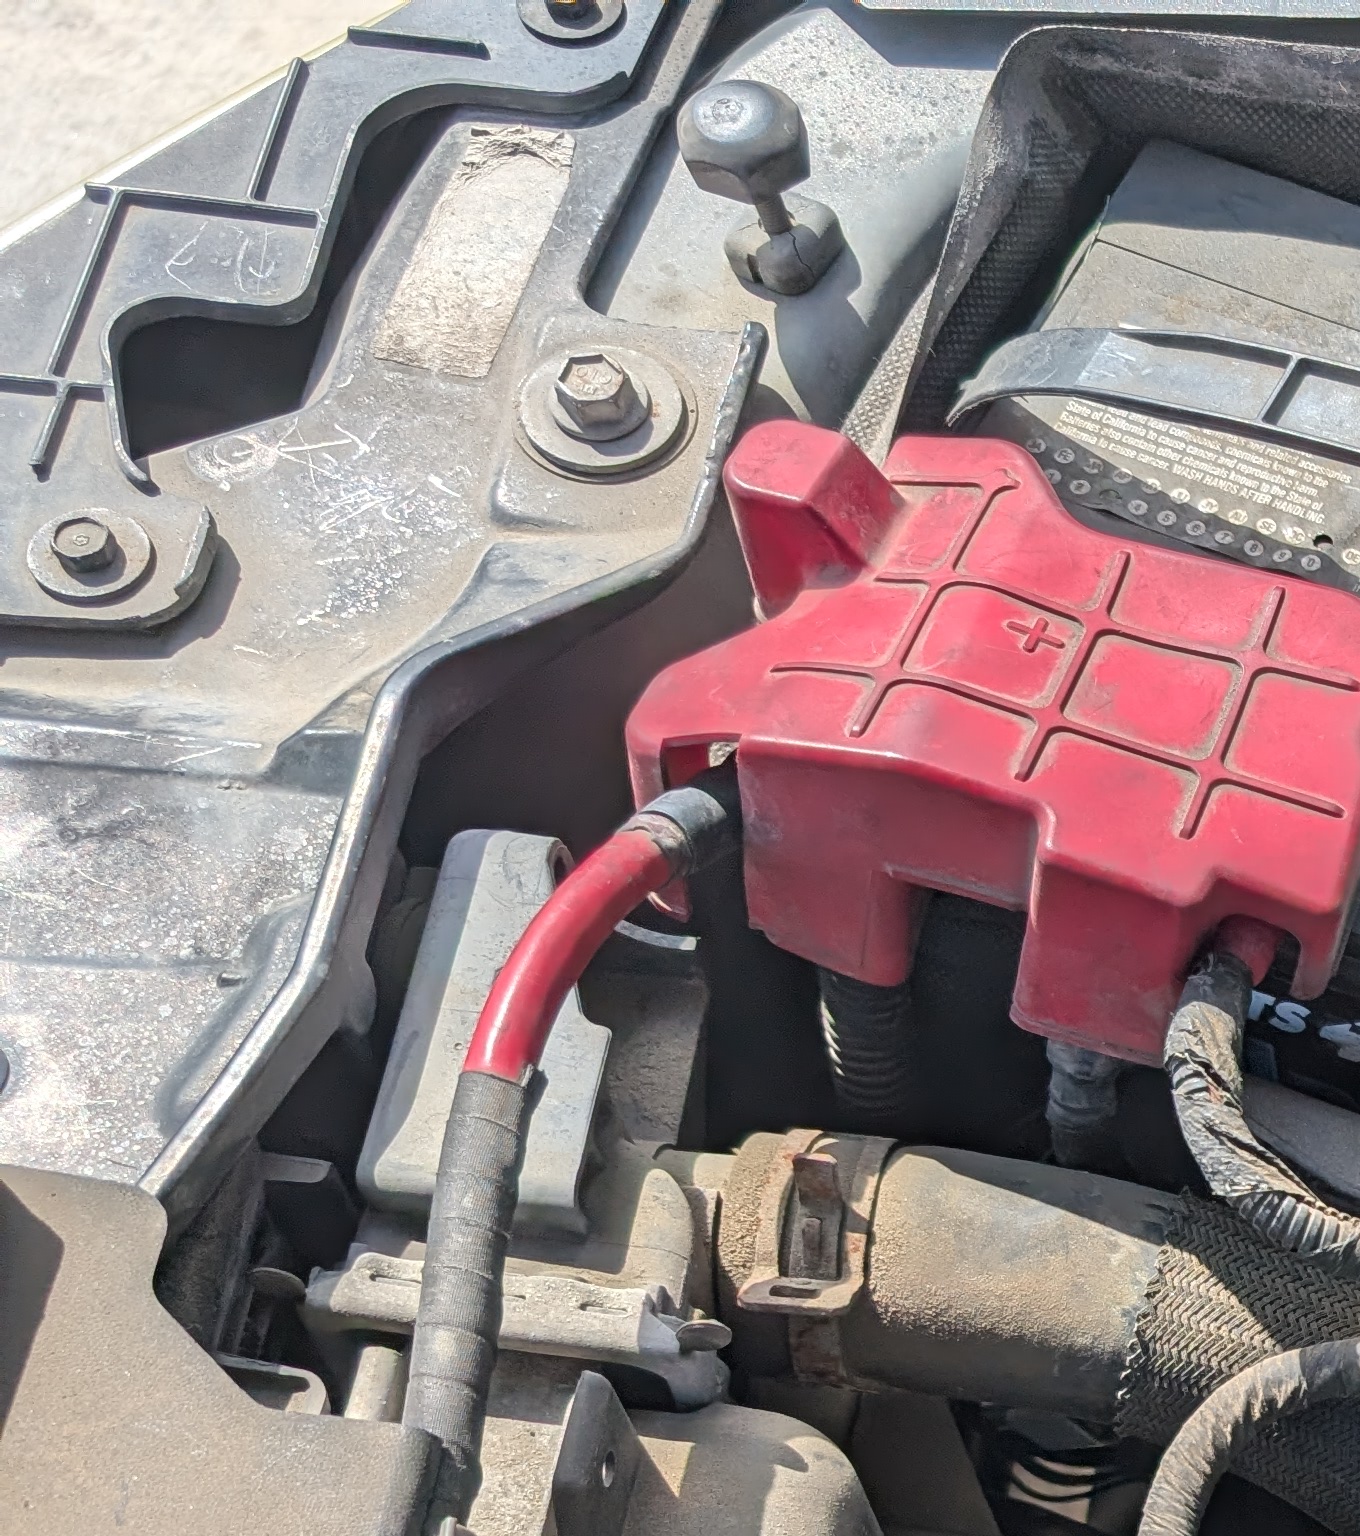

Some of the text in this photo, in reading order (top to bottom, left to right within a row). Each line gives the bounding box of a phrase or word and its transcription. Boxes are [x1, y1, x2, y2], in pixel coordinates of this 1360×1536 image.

[1065, 400, 1091, 417] State
[1089, 408, 1104, 422] of
[1102, 413, 1147, 436] California
[1146, 428, 1159, 441] to
[1157, 434, 1186, 450] cause
[1185, 444, 1217, 461] cancer
[1217, 454, 1236, 467] and
[1147, 418, 1168, 431] lead
[1059, 411, 1101, 433] Batteries
[1100, 425, 1122, 440] also
[1121, 433, 1156, 452] contain
[1156, 445, 1182, 461] other
[1181, 455, 1229, 478] chemicals
[1228, 471, 1259, 488] known
[1259, 481, 1272, 493] to
[1270, 485, 1286, 497] the
[1286, 491, 1312, 506] State
[1310, 499, 1324, 511] of
[1298, 458, 1352, 484] accessories
[1171, 464, 1202, 481] WASH
[1202, 475, 1238, 494] HANDS
[1238, 486, 1272, 506] AFTER
[1271, 498, 1327, 525] HANDLING.
